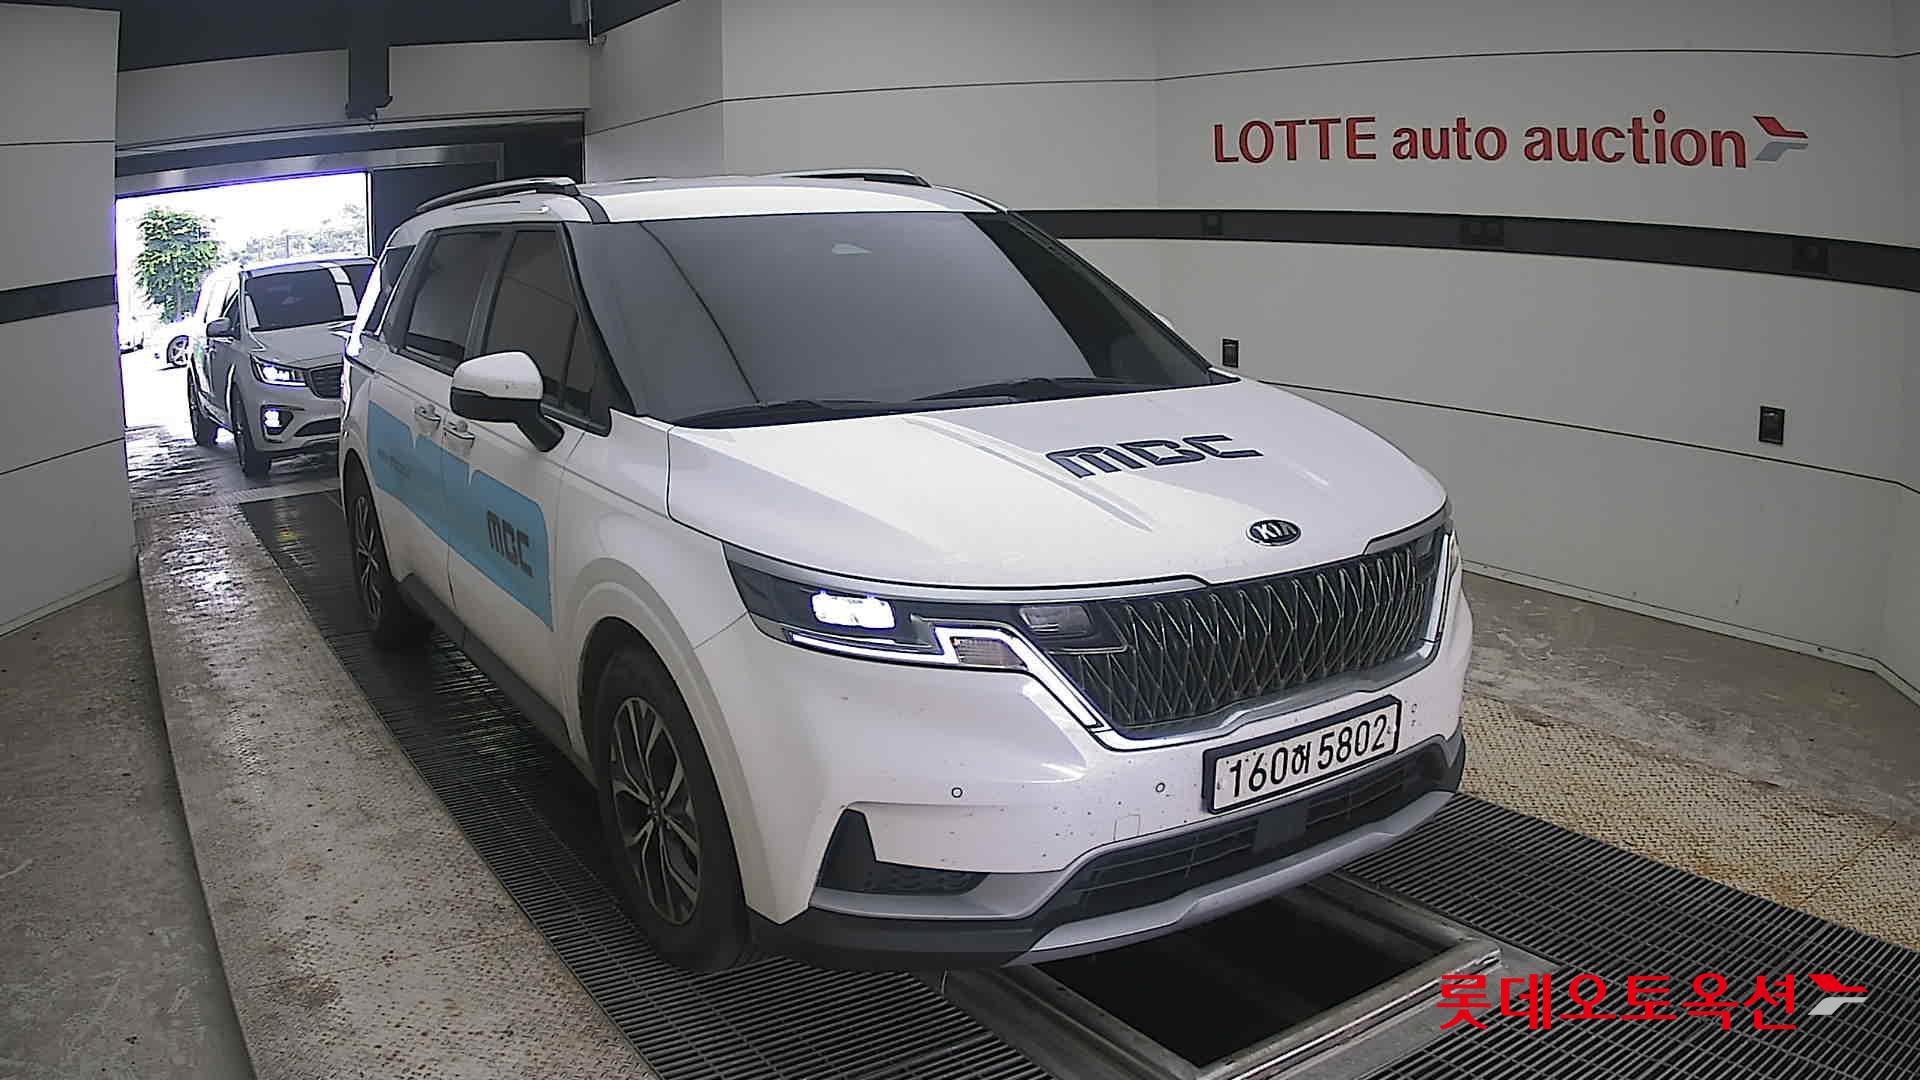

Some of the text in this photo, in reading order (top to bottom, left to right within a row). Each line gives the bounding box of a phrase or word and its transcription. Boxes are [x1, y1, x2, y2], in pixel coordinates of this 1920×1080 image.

[1213, 109, 1748, 169] LOTTE auto auction
[1046, 434, 1264, 478] MBC
[486, 509, 534, 578] MBC
[1252, 522, 1297, 540] KIA
